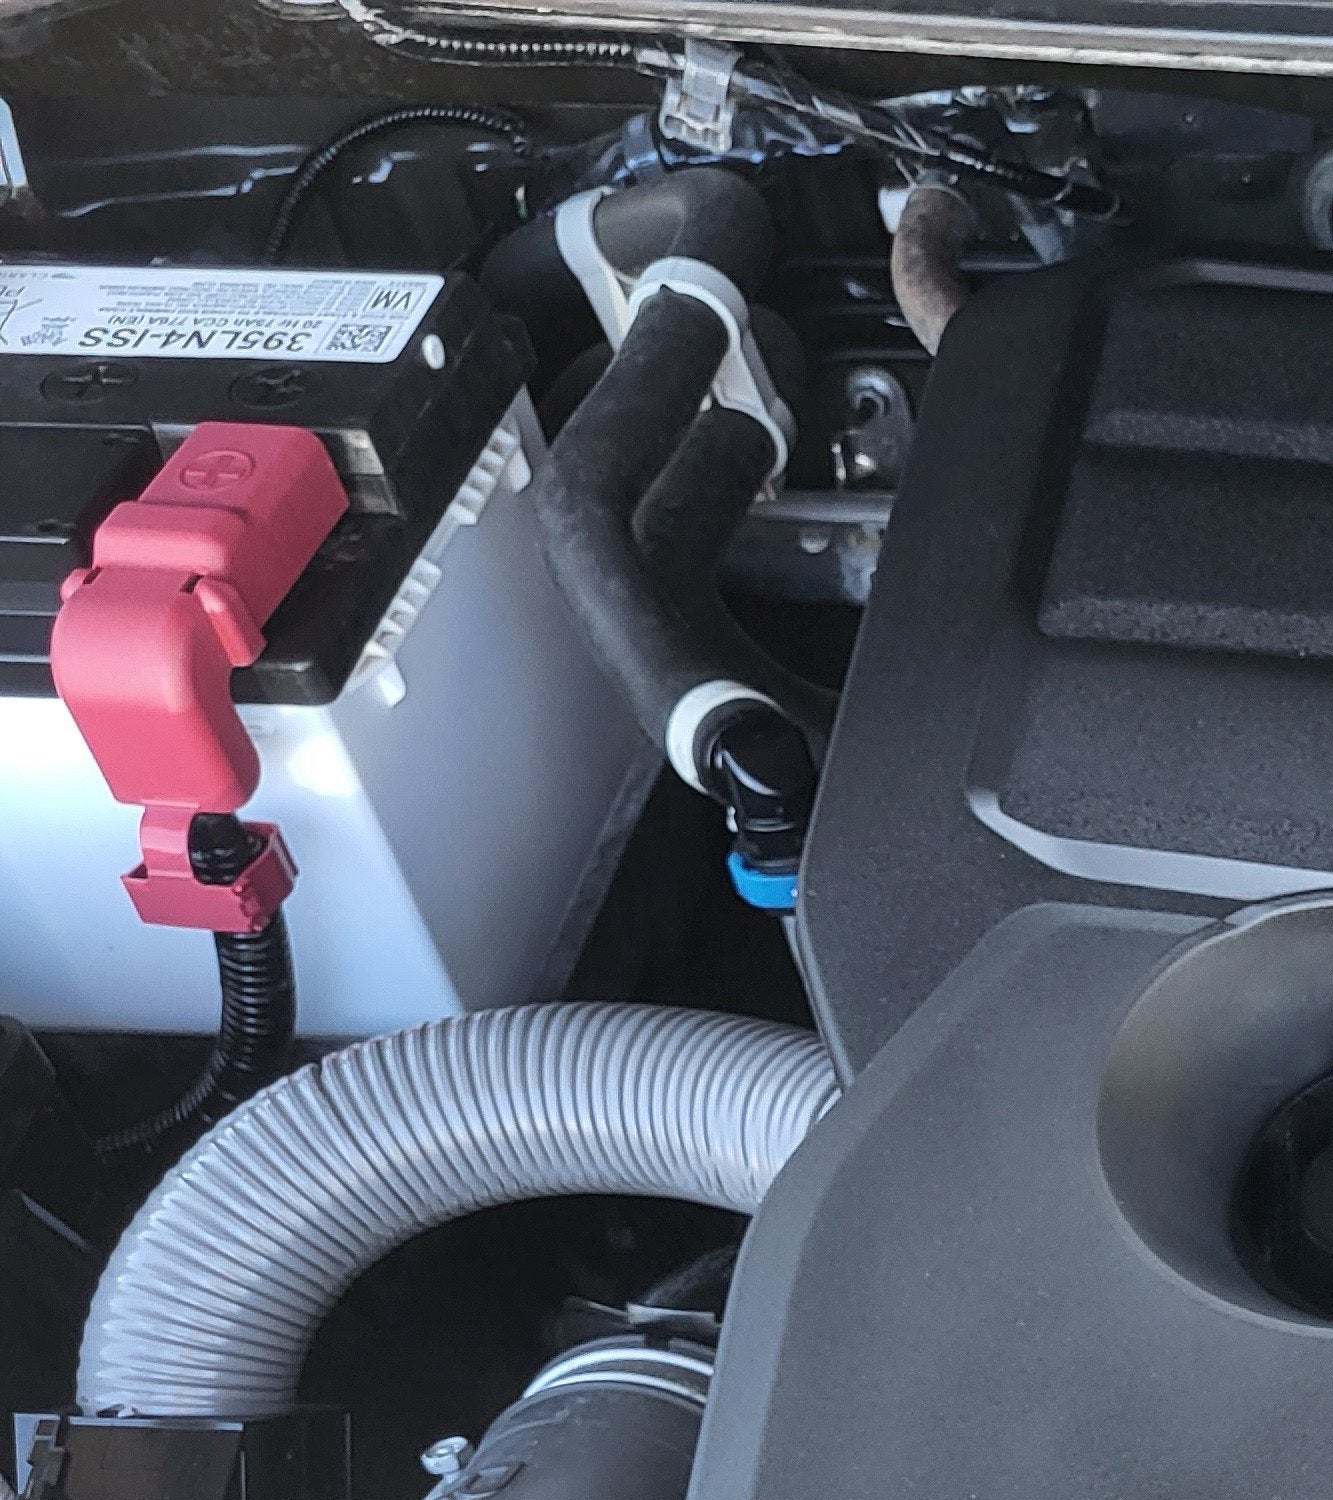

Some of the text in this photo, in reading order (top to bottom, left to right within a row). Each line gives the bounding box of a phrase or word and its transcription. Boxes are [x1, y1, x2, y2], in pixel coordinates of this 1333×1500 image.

[371, 288, 412, 311] VM
[193, 316, 228, 327] CCA
[78, 326, 312, 352] 395LN4-ISS
